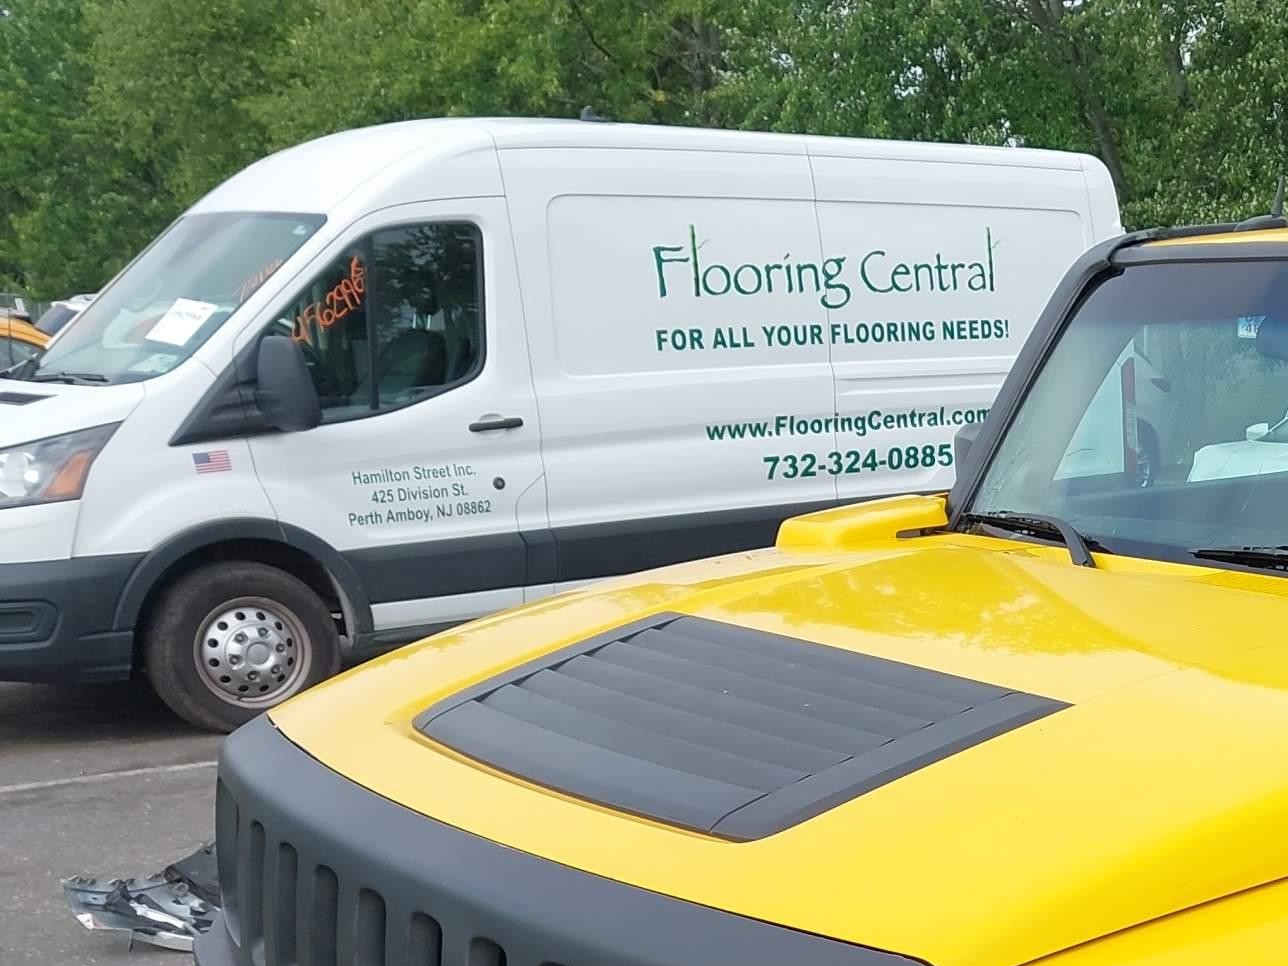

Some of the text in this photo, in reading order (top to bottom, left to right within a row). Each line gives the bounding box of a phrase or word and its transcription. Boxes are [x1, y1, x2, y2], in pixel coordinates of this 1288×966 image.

[653, 224, 995, 309] Flooring Central
[656, 319, 1009, 351] FOR ALL YOUR FLOORING NEEDS!
[351, 463, 476, 485] Hamilton Street Inc.
[763, 443, 953, 480] 732-324-0885
[371, 483, 469, 504] 425 Division St.
[348, 500, 491, 527] Perth Amboy, NJ 08862
